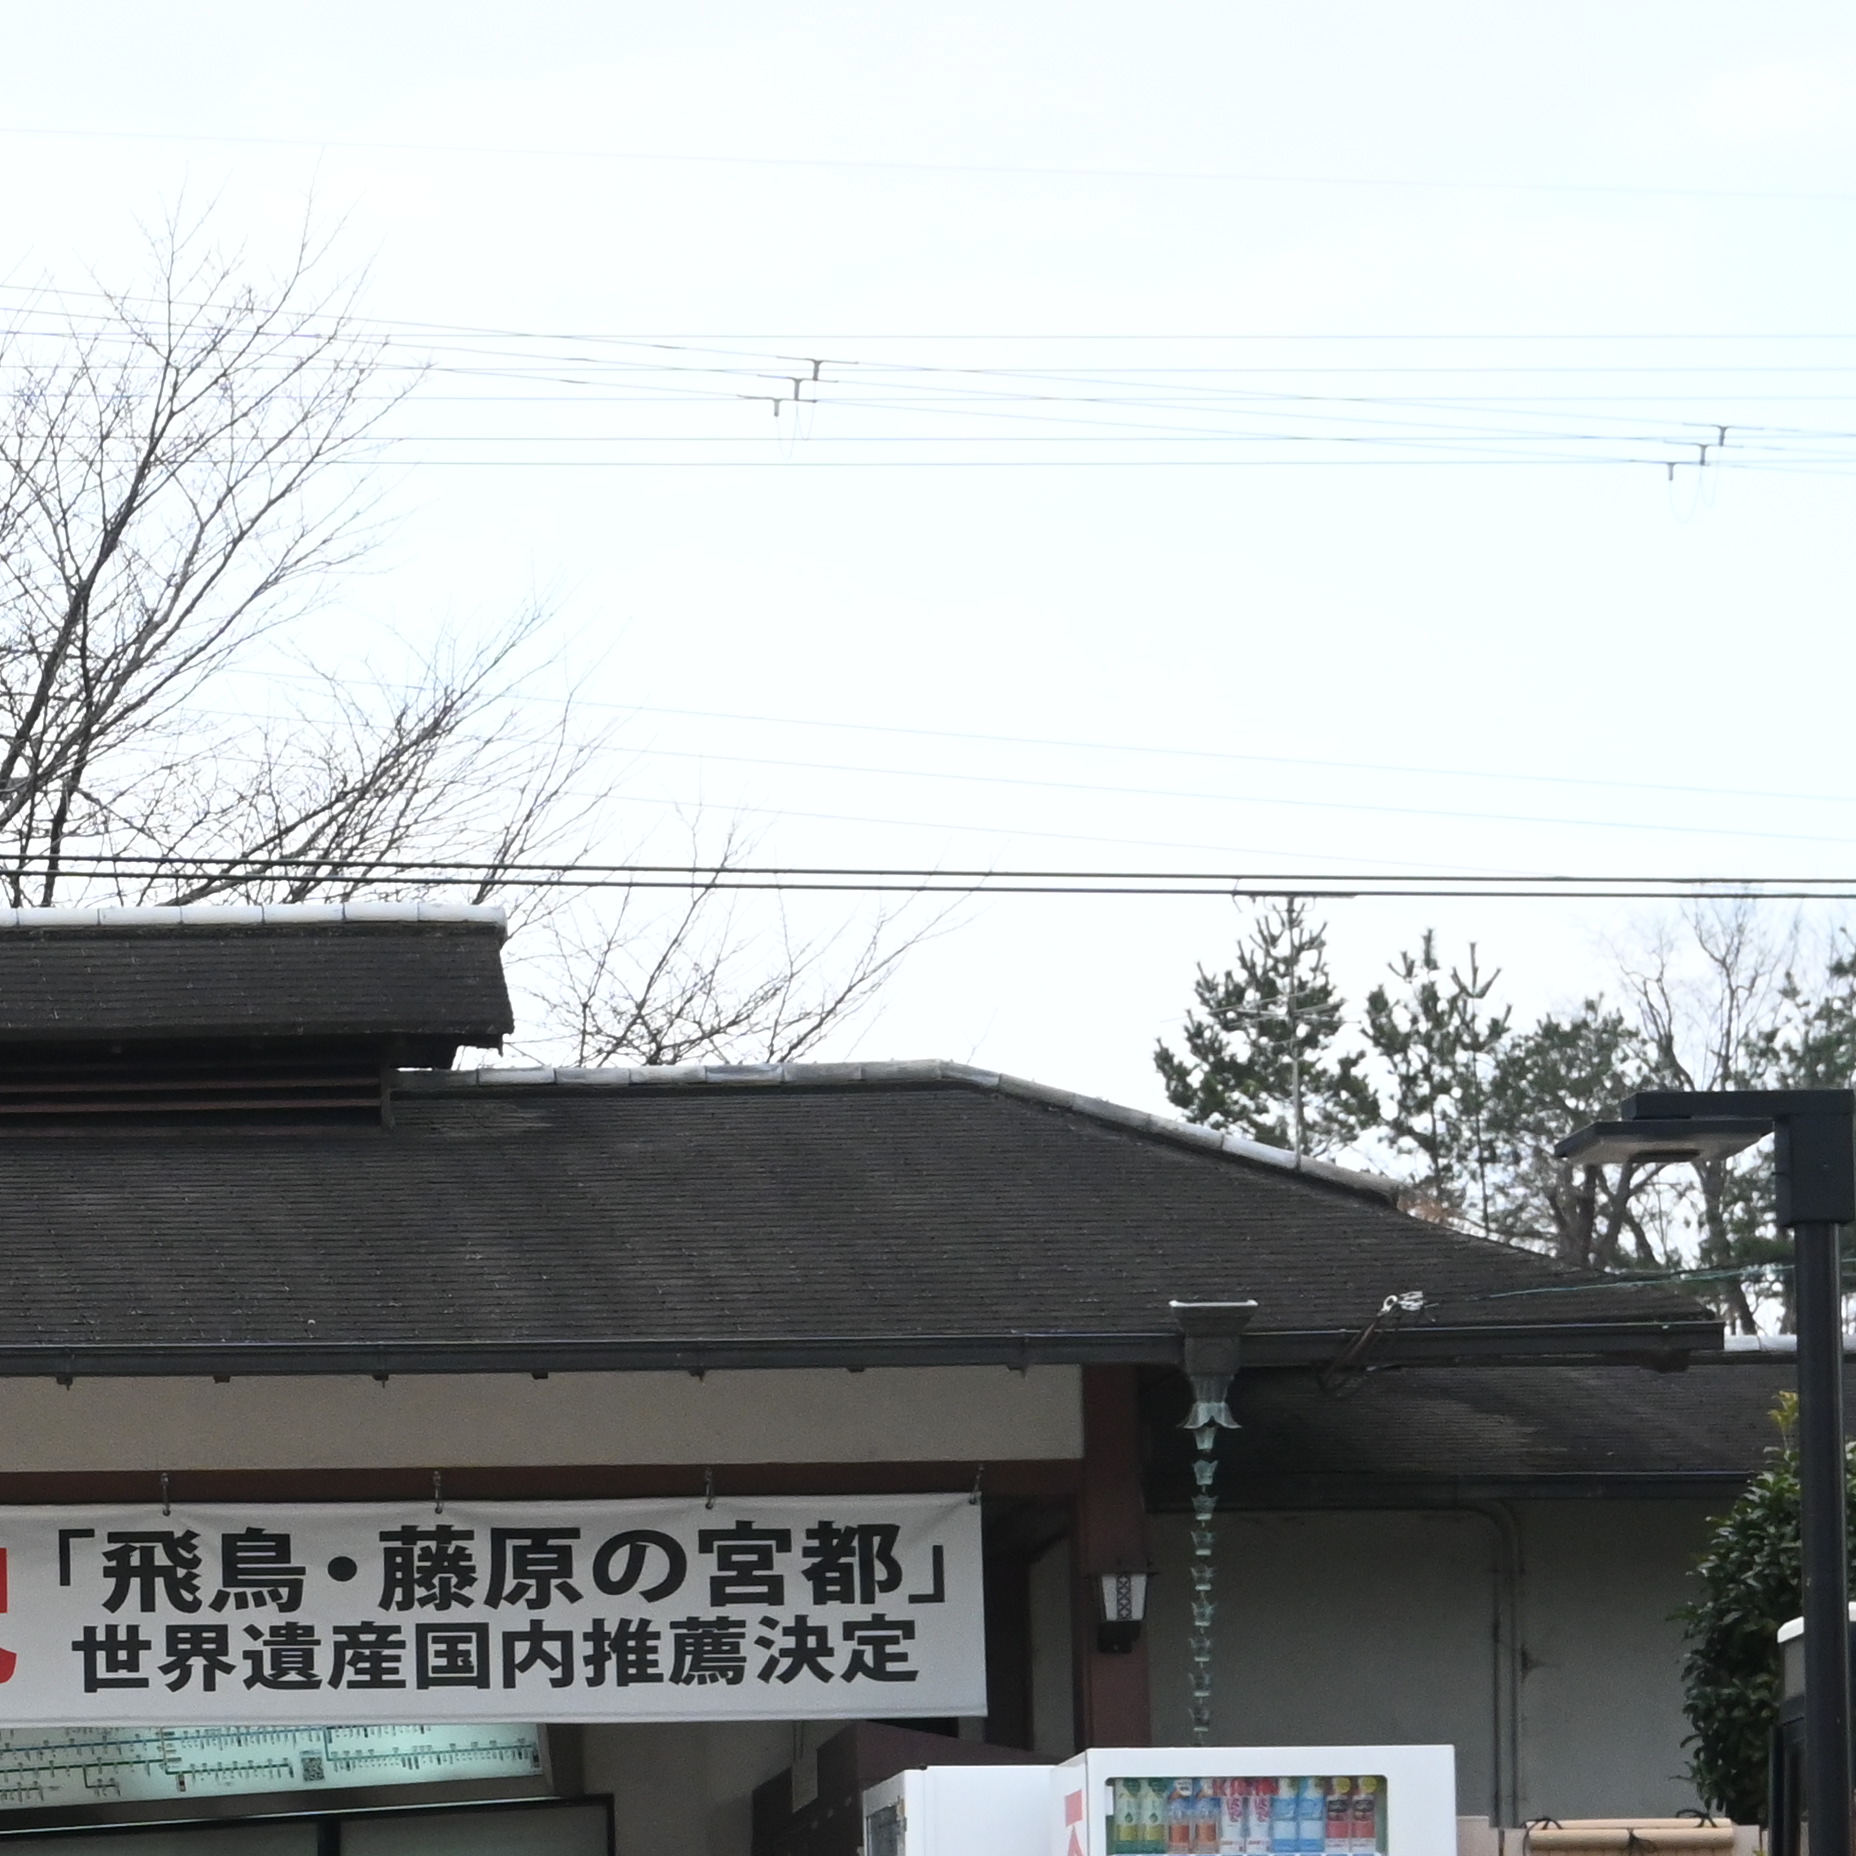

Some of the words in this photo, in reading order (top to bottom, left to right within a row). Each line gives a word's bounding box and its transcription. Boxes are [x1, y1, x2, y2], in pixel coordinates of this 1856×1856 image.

[57, 1519, 947, 1613] 「飛鳥・藤原の宮都」
[71, 1613, 920, 1694] 世界遺産国内推薦決定
